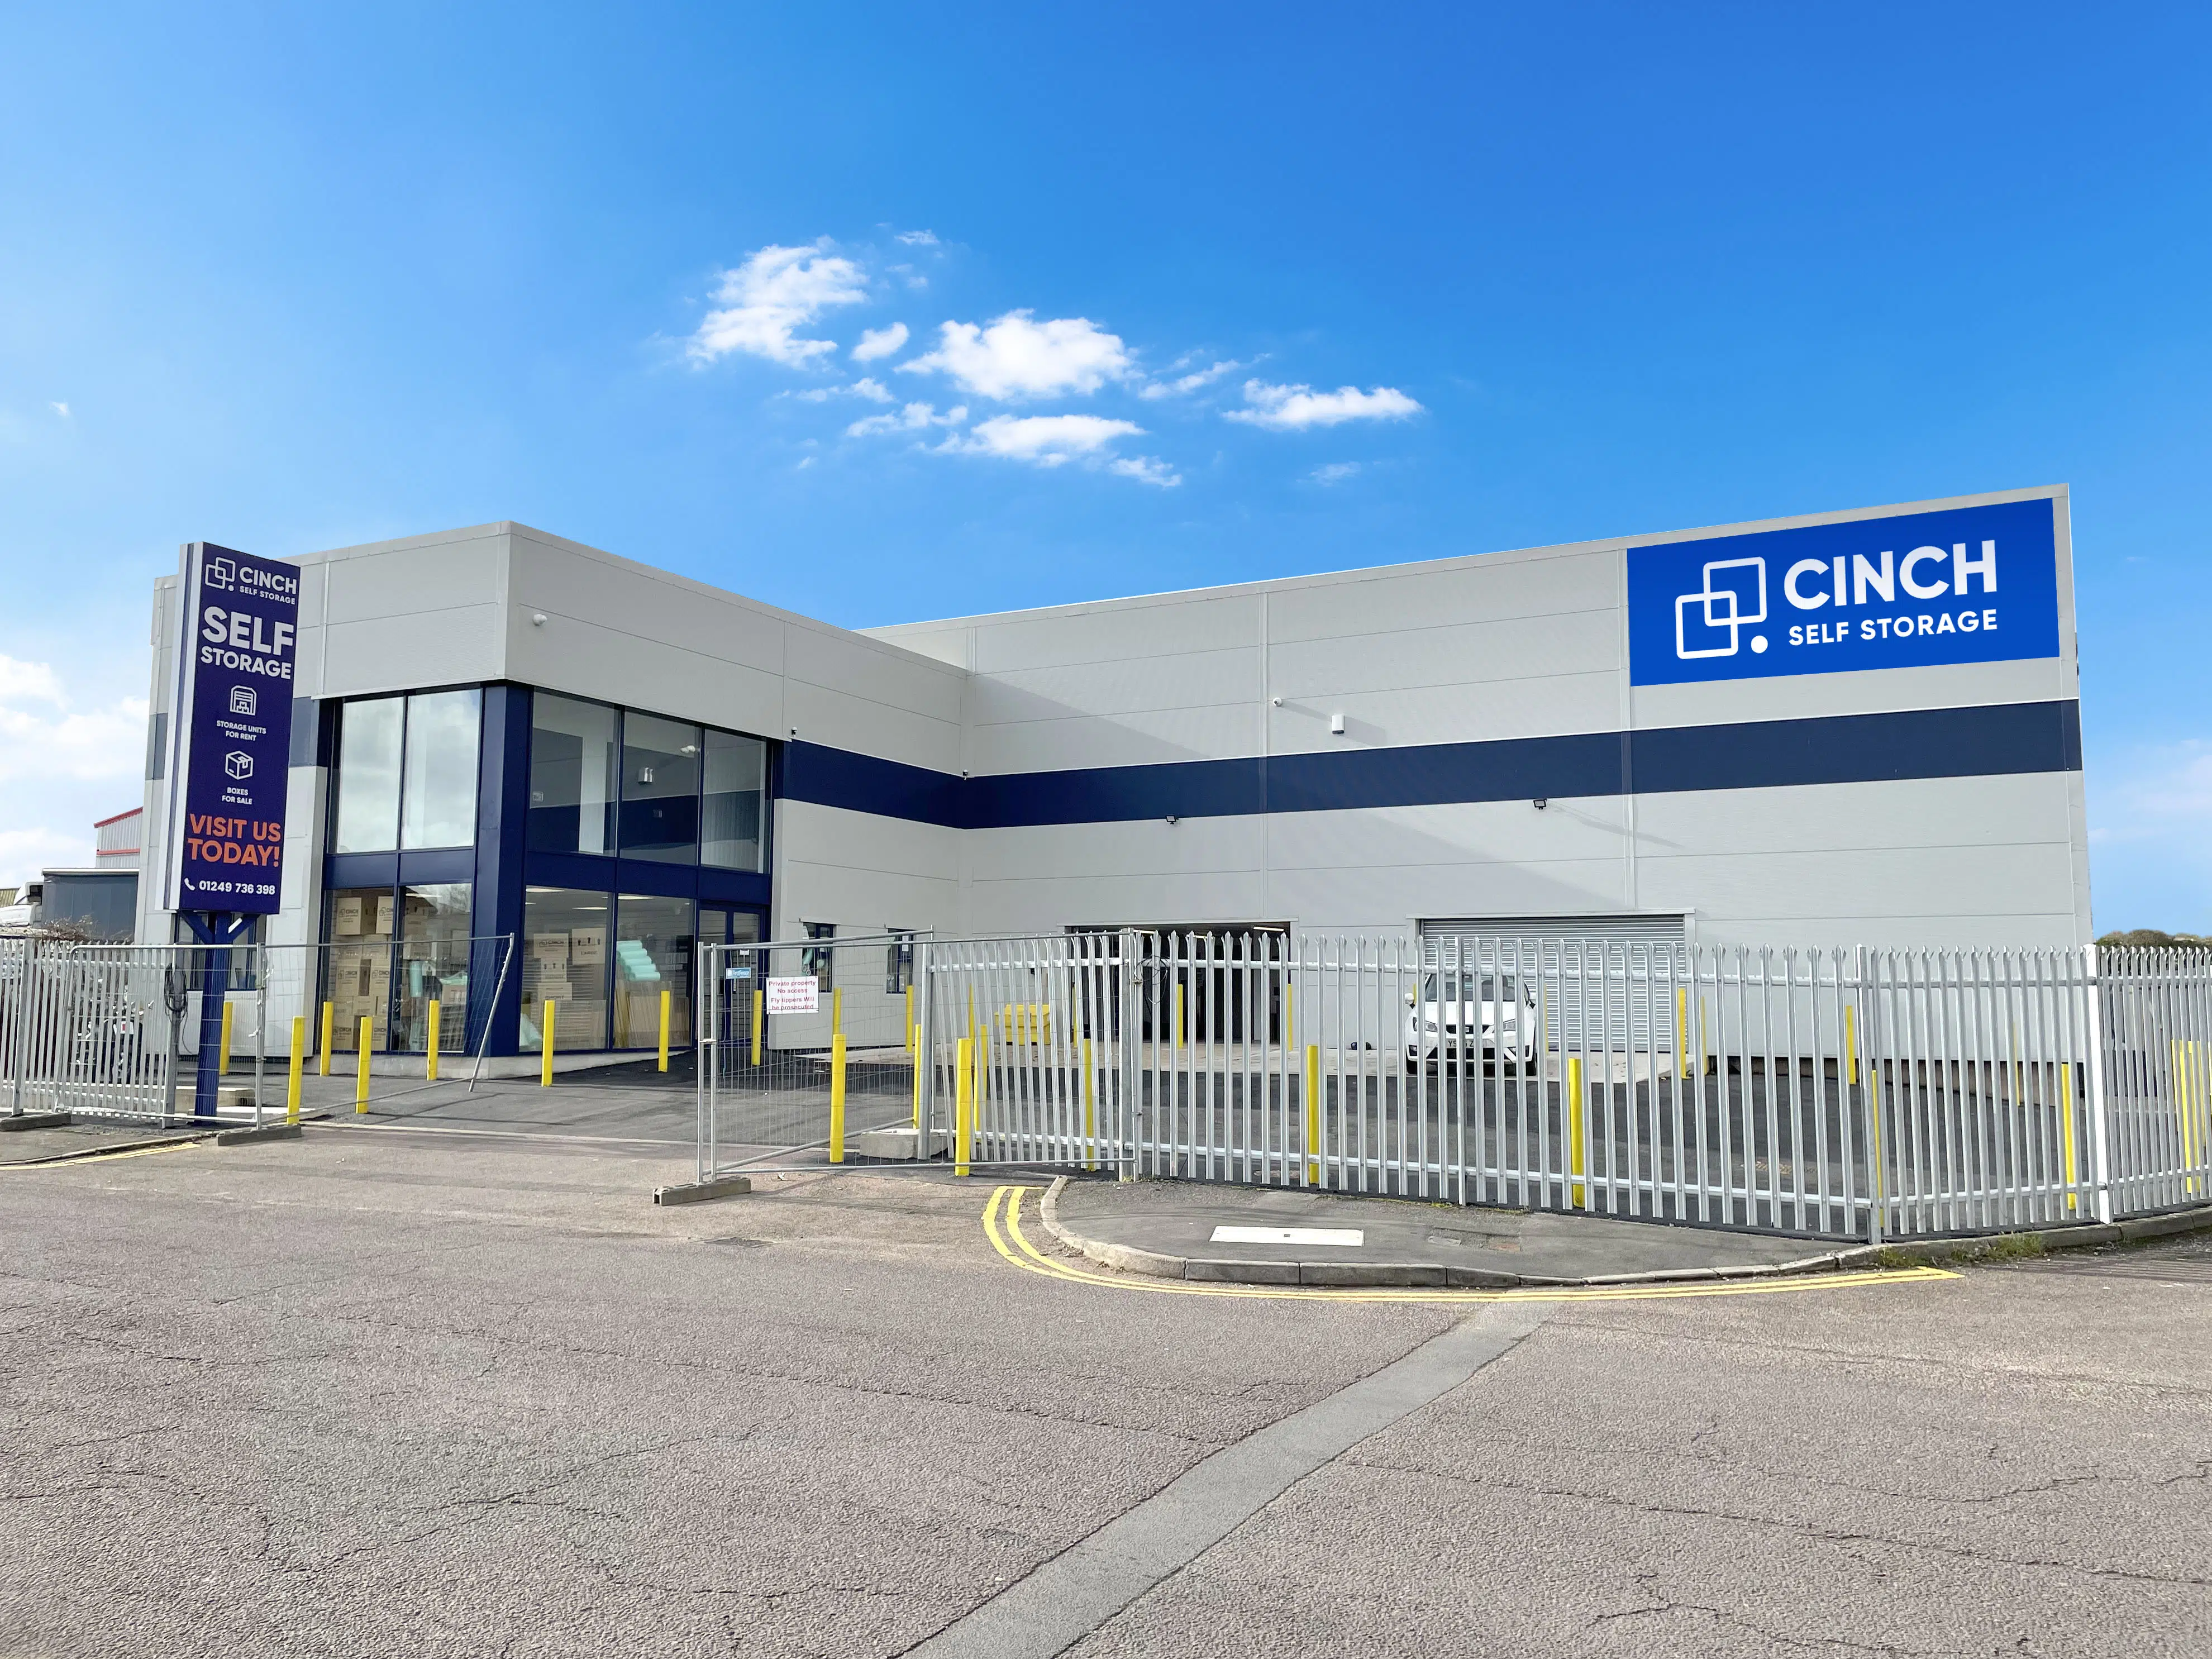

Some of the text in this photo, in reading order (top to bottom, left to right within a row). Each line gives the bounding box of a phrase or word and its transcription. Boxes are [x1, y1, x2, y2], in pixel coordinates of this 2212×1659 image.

[239, 566, 297, 595] CINCH
[1784, 539, 1998, 611] CINCH
[240, 585, 295, 605] SELF STORAGE
[202, 606, 294, 656] SELF
[1788, 608, 1998, 646] SELF STORAGE
[201, 646, 292, 680] STORAGE
[216, 720, 266, 735] STORAGE UNITS
[240, 732, 257, 741] RENT
[227, 786, 249, 795] BOXES
[236, 797, 252, 805] SALE
[189, 813, 281, 842] VISIT US
[188, 838, 280, 867] TODAY!
[199, 880, 275, 895] 01249 736 398
